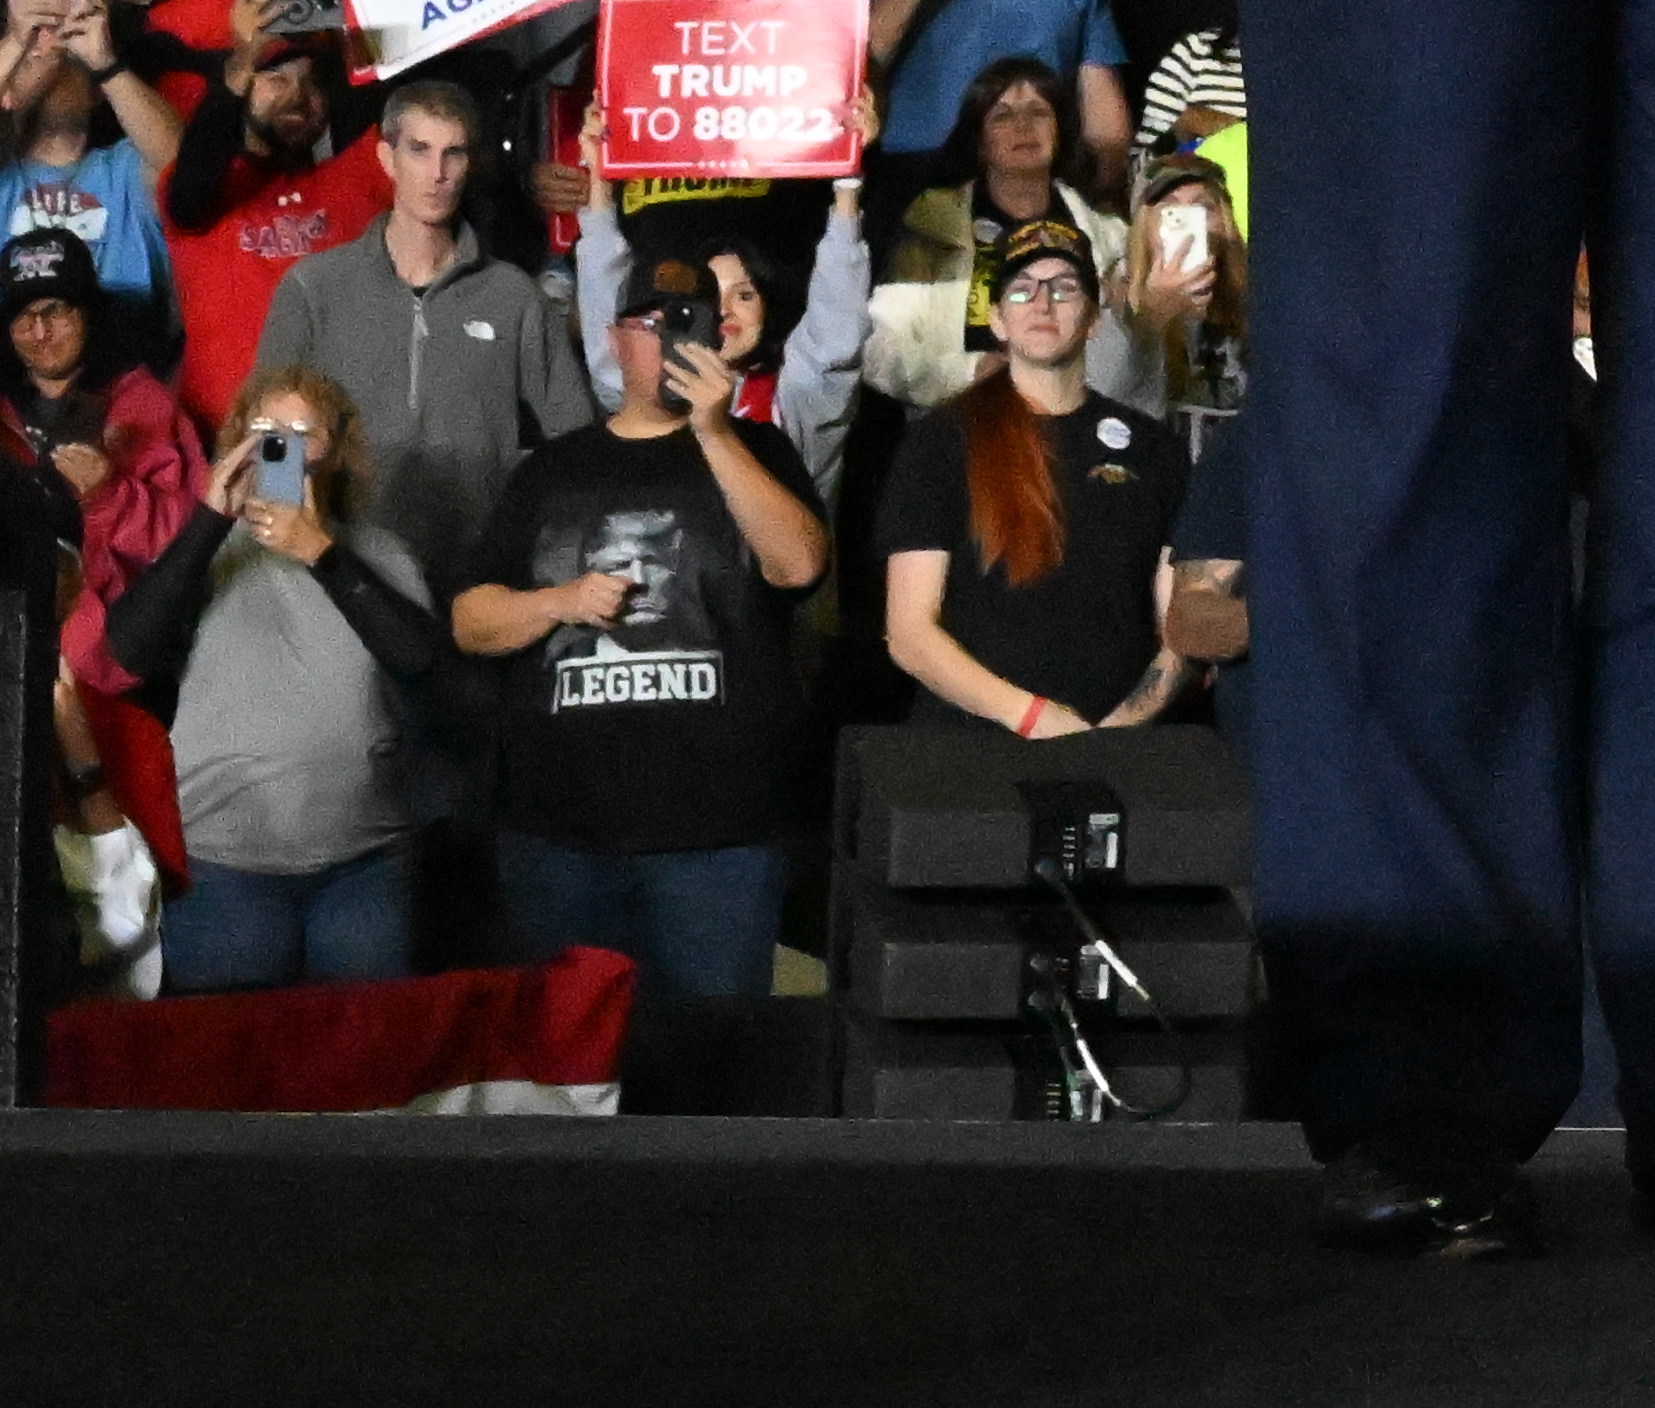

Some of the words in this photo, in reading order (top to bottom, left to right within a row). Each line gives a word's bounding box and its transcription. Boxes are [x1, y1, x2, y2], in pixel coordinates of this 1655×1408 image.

[673, 21, 787, 55] TEXT
[652, 64, 807, 98] TRUMP
[623, 107, 681, 142] TO
[694, 105, 835, 141] 88022
[560, 662, 717, 707] LEGEND
